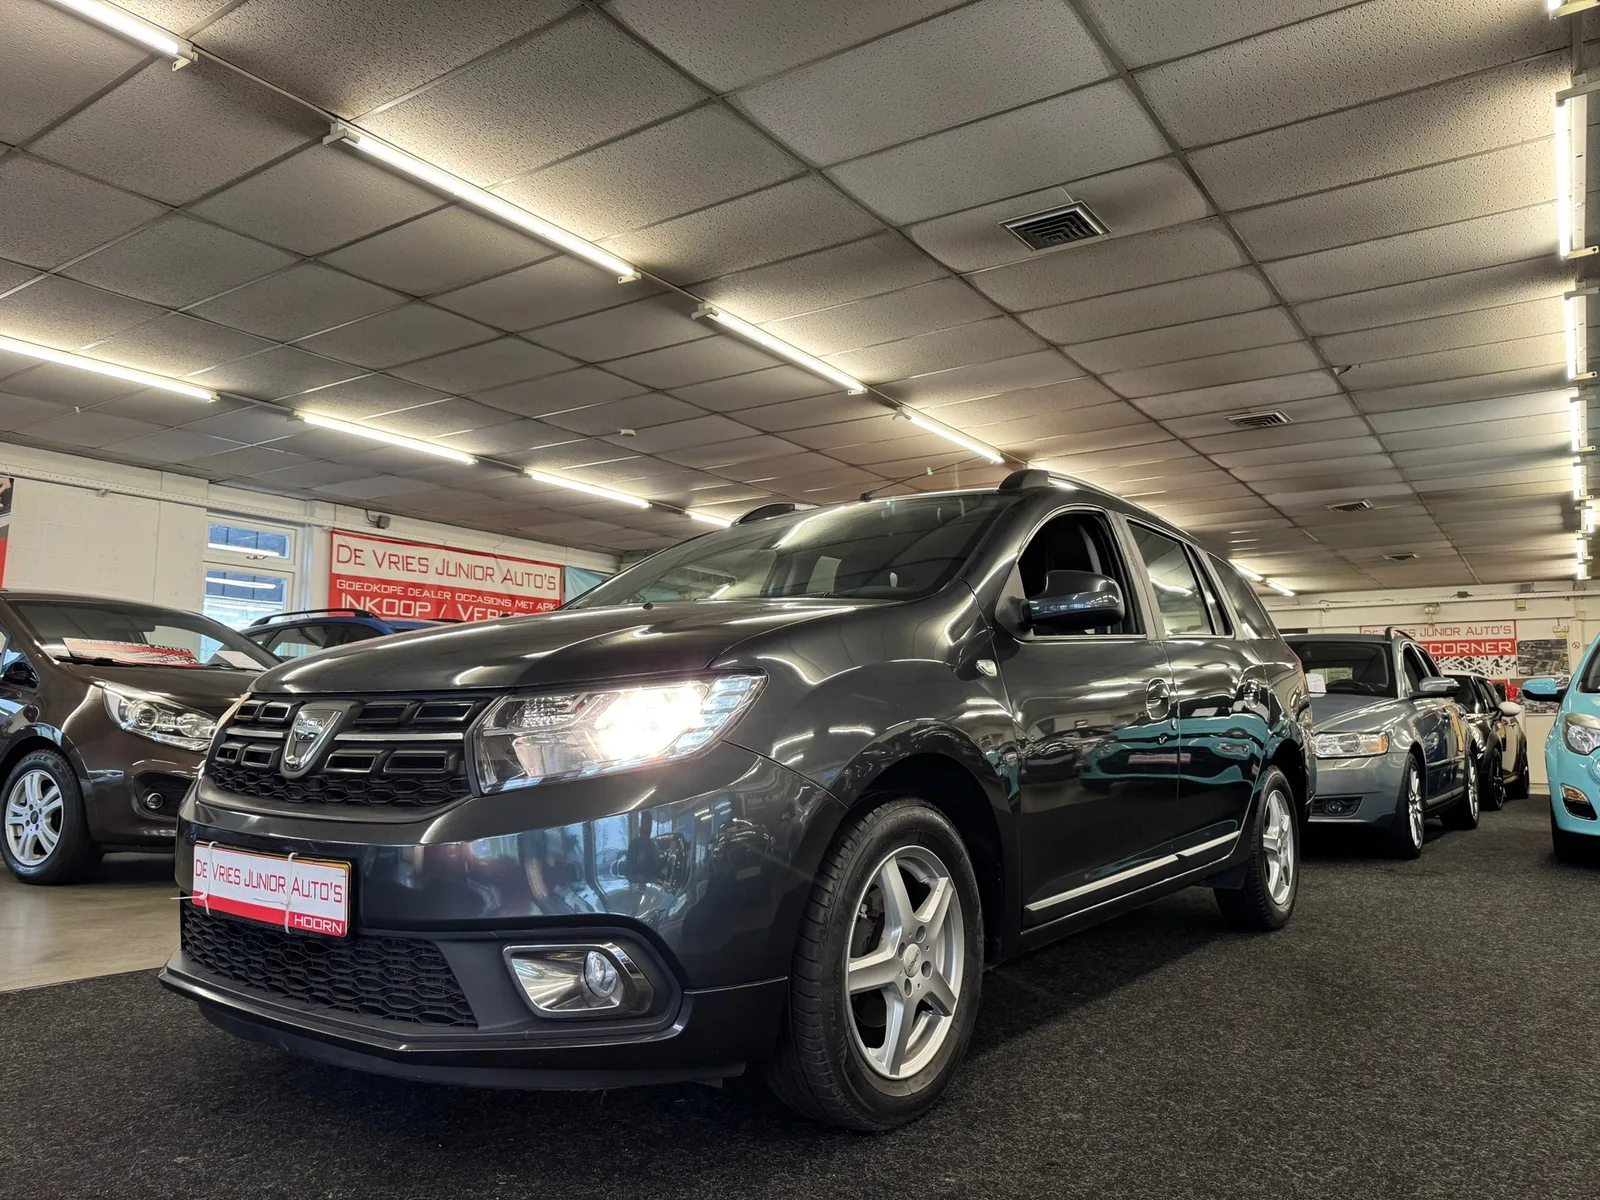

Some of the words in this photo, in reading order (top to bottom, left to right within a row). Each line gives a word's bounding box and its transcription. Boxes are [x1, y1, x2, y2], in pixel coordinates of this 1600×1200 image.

[336, 545, 366, 567] DE
[371, 549, 429, 574] VRIES
[435, 558, 495, 583] JUNIOR
[502, 567, 557, 591] AUTO'S
[336, 579, 405, 596] GOEDKOPE
[407, 587, 452, 600] DEALER
[455, 592, 512, 607] OCCASIONS
[514, 599, 534, 610] MET
[535, 602, 556, 611] APK
[341, 592, 431, 617] INKOOP
[1420, 627, 1461, 637] JUNIOR
[1466, 625, 1512, 636] AUTO'S
[195, 858, 208, 878] DE
[211, 861, 240, 886] VRIES
[244, 868, 286, 894] JUNIOR
[291, 876, 343, 903] AUTO'S
[294, 914, 343, 934] HOORN
